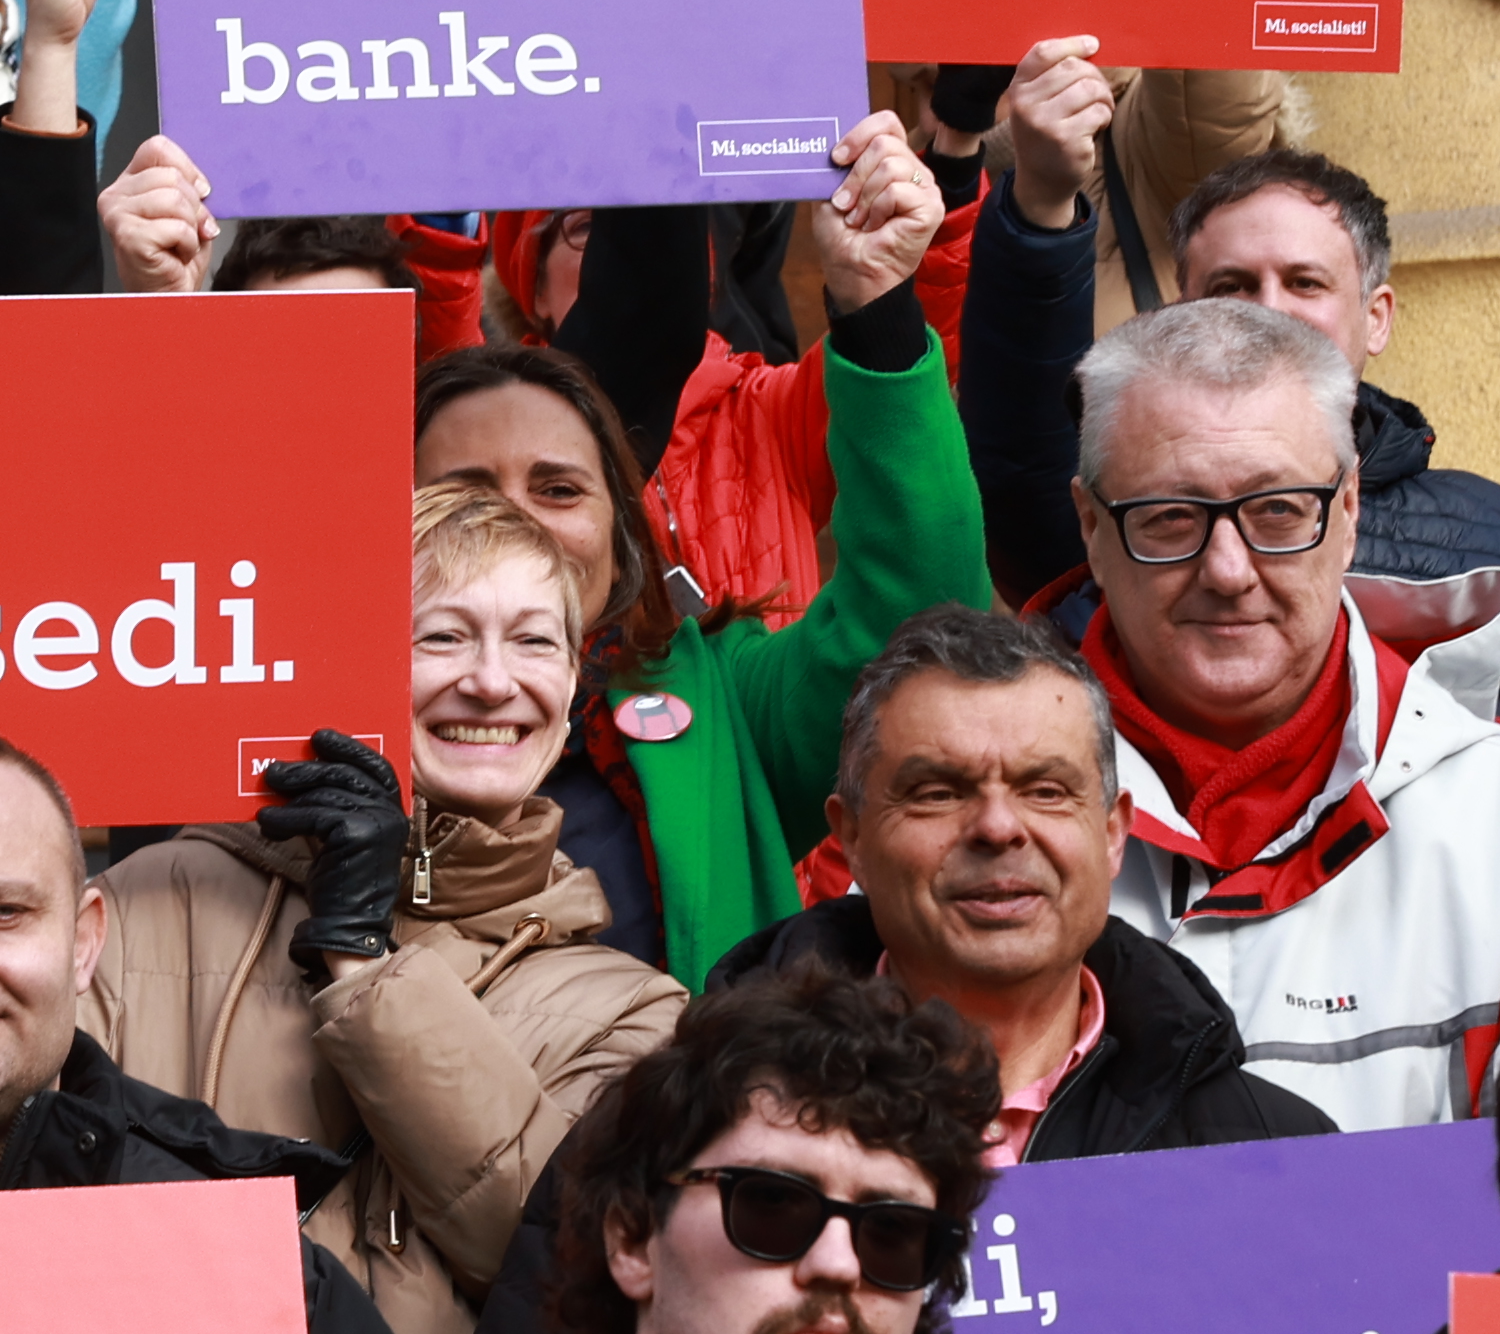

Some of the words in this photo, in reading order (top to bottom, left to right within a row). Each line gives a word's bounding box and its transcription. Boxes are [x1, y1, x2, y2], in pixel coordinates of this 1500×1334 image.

[1264, 19, 1290, 35] Mi,
[1291, 20, 1367, 36] socialisti!
[216, 12, 600, 103] banke.
[711, 140, 739, 157] Mi,
[741, 136, 827, 156] socialisti!
[949, 1213, 1058, 1327] i,
